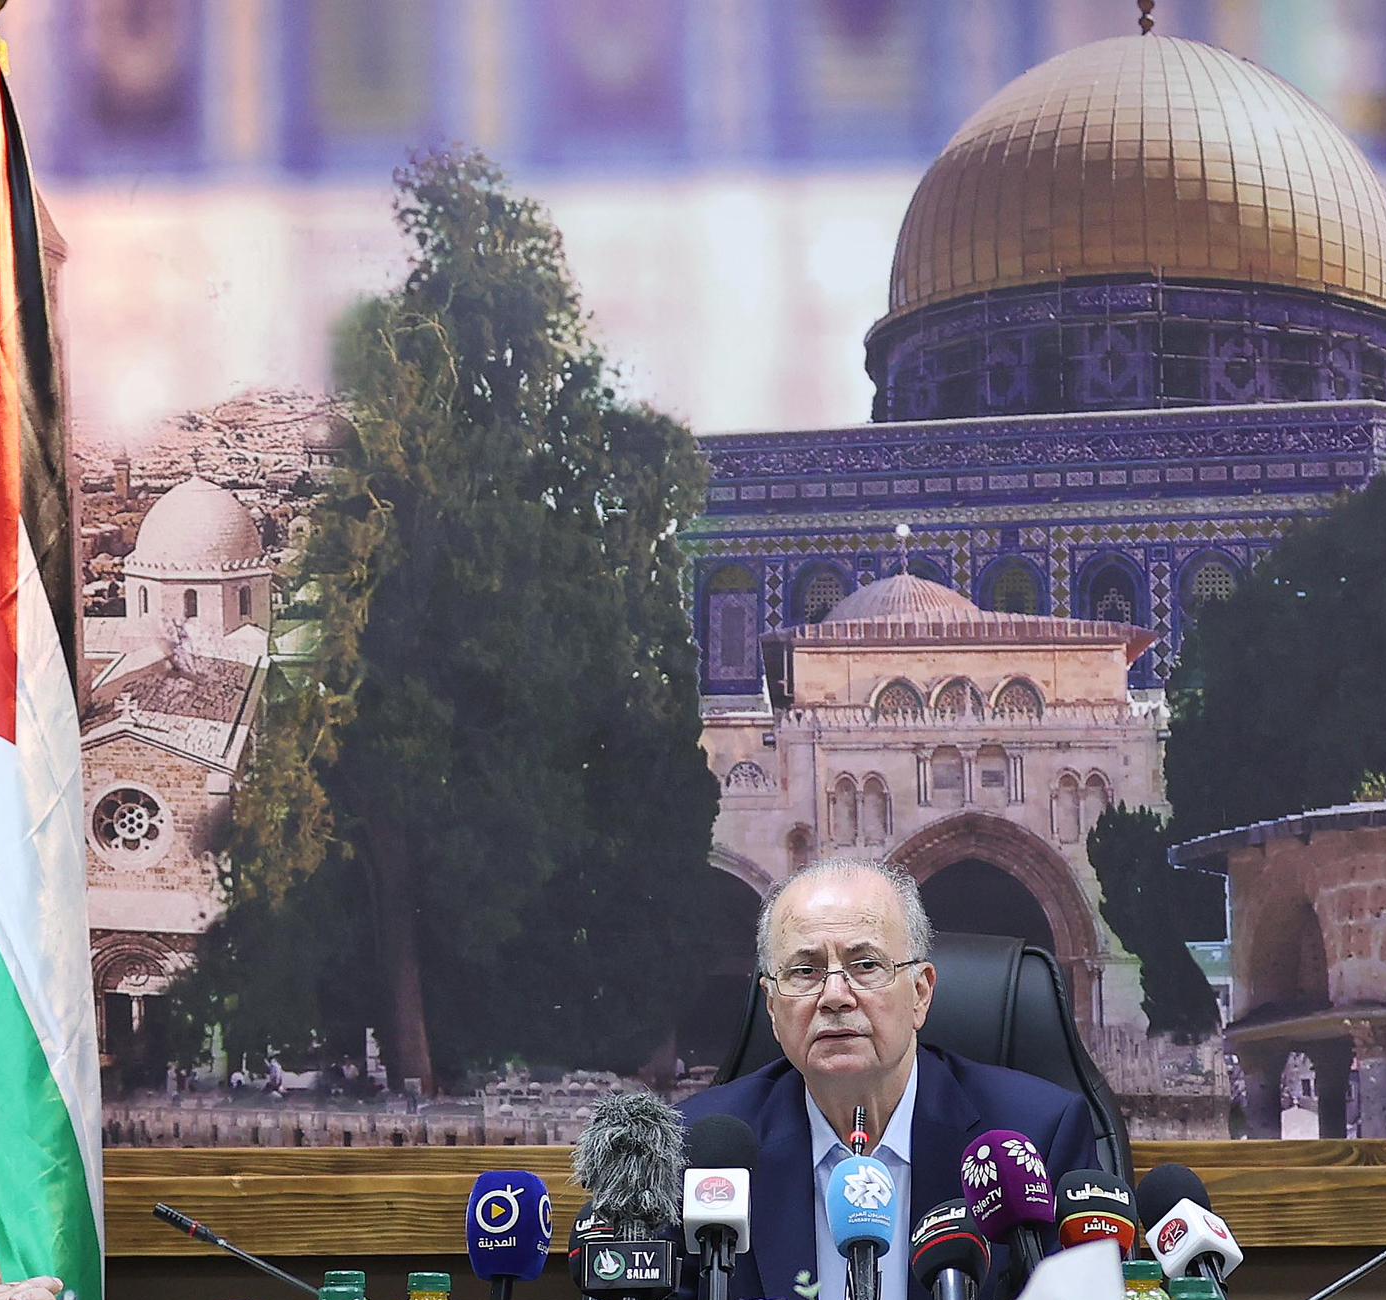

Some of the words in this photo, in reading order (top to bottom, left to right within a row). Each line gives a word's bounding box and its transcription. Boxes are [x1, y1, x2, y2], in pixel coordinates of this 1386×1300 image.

[1025, 1181, 1048, 1195] الفجر
[1083, 1217, 1119, 1235] مباشر
[477, 1236, 517, 1251] المدينة
[631, 1251, 656, 1268] TV
[626, 1268, 661, 1281] SALAM
